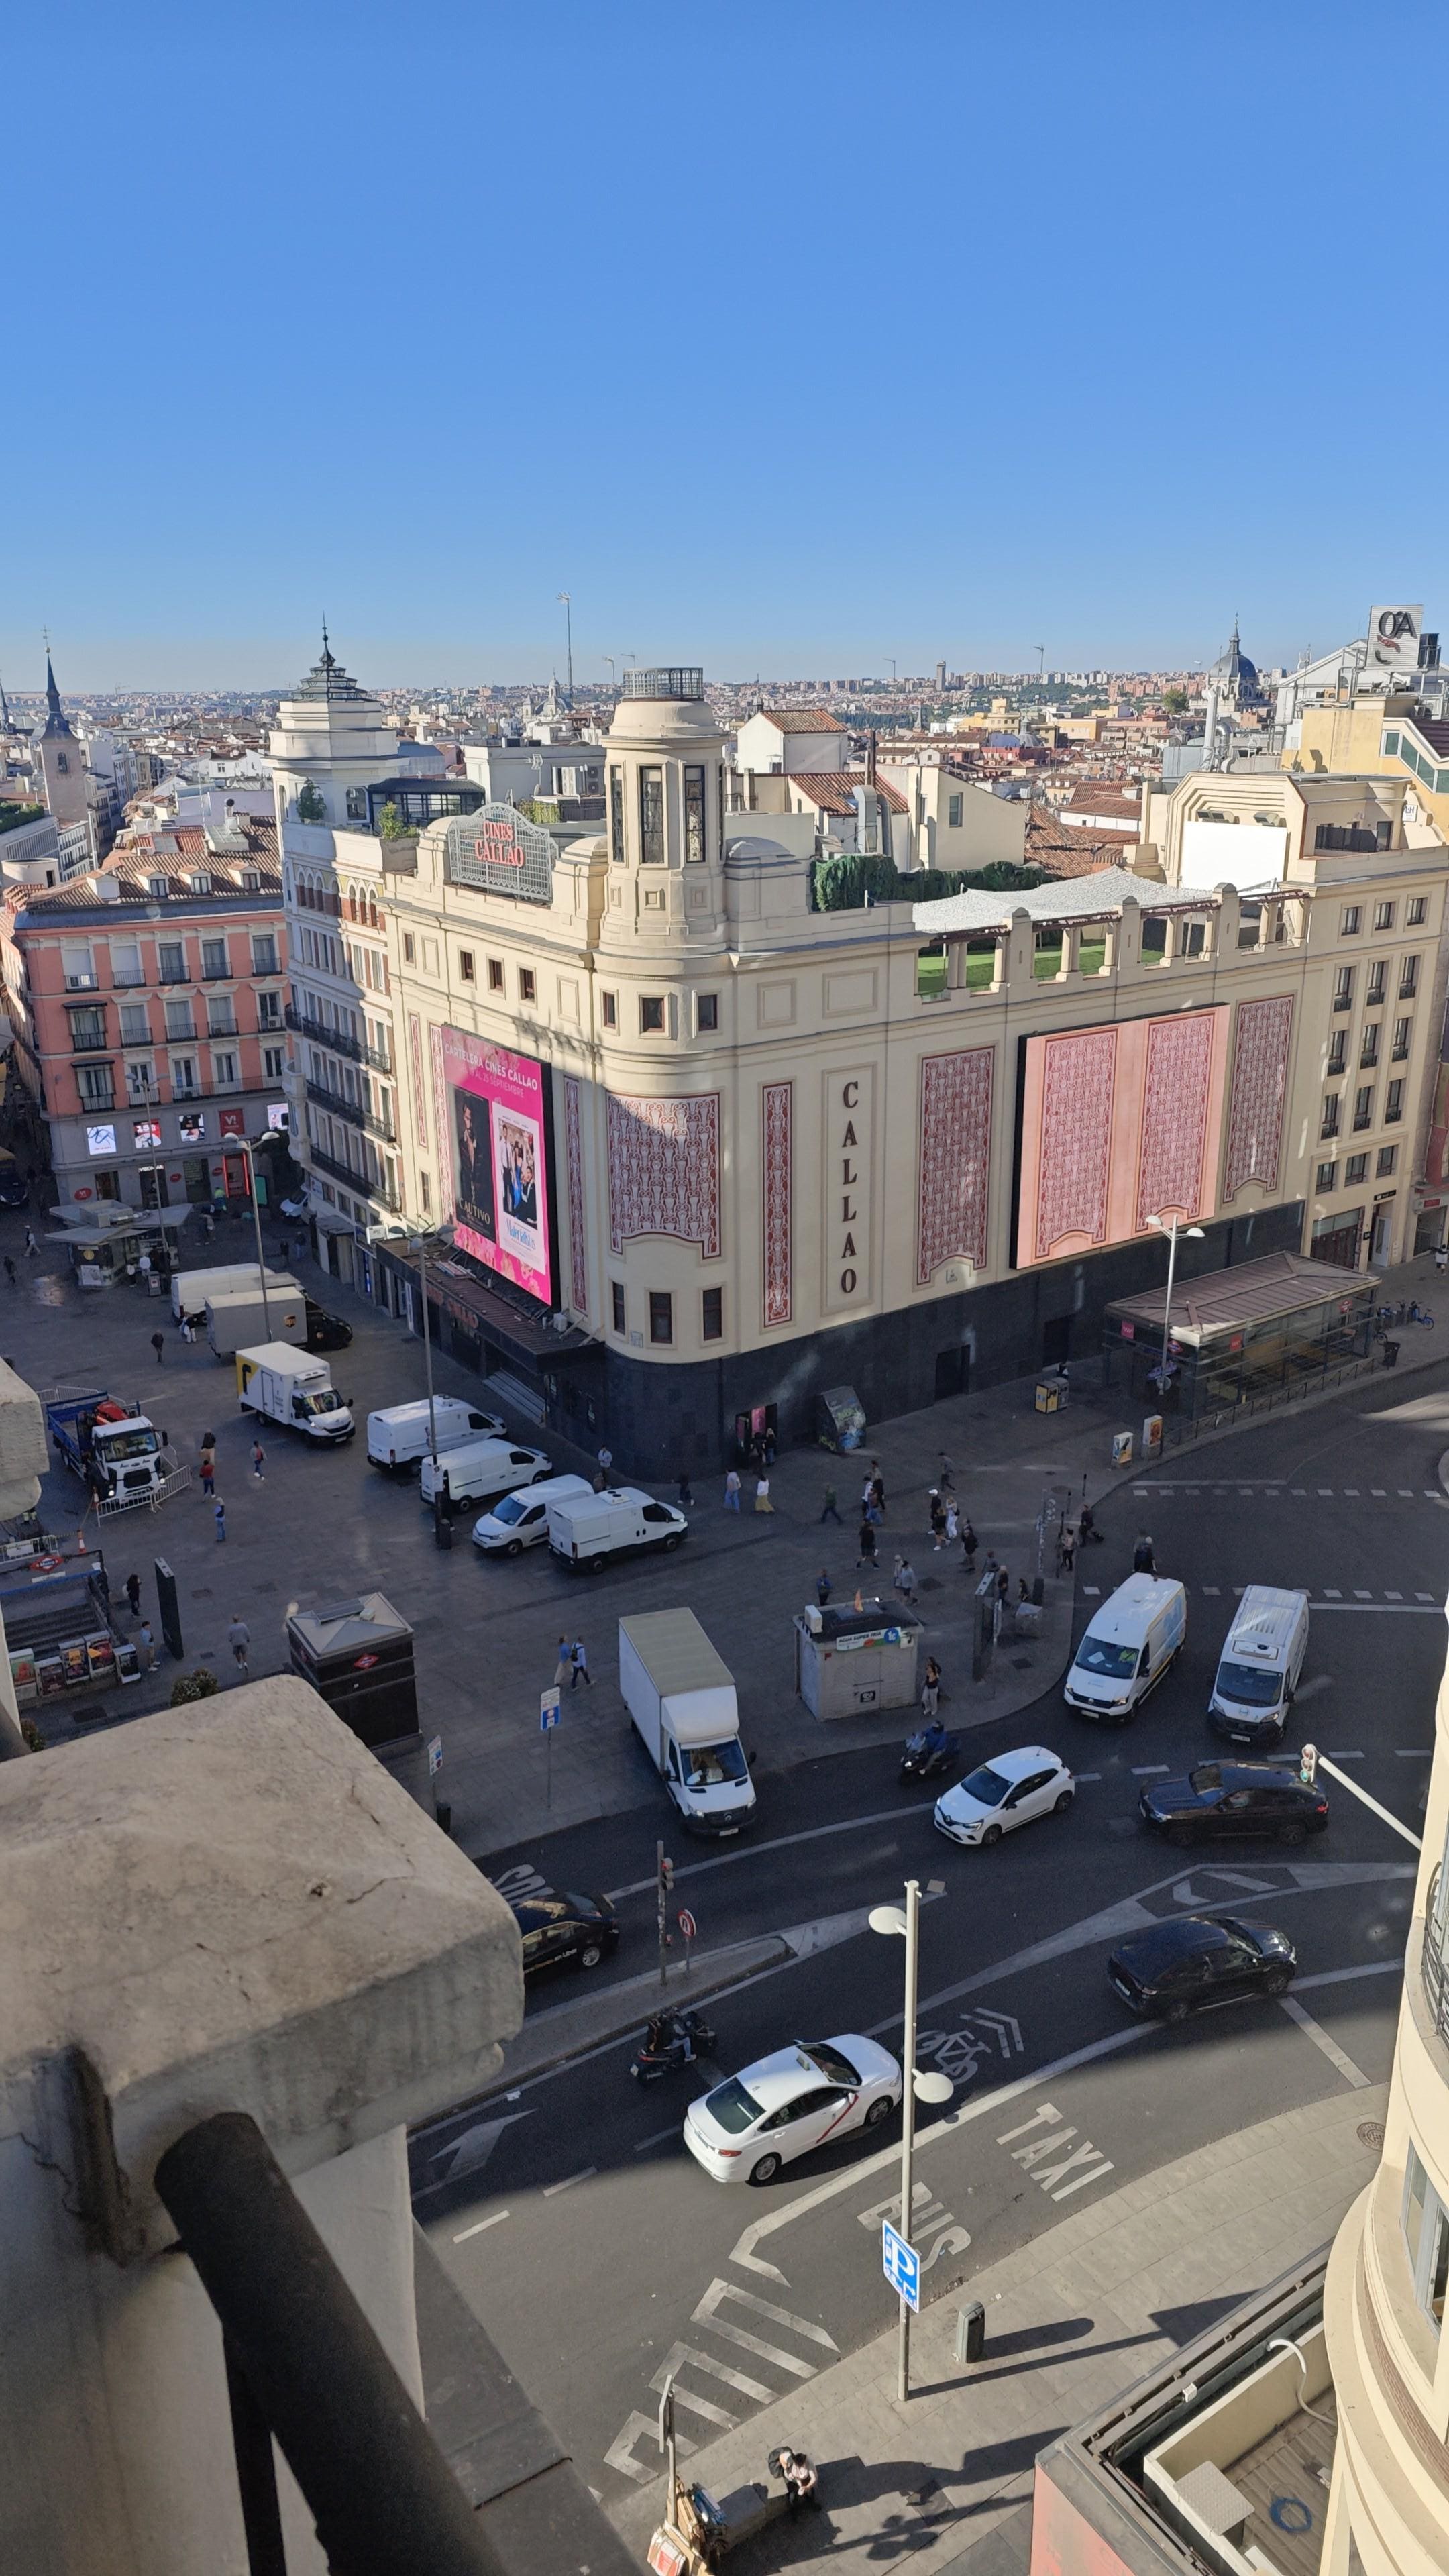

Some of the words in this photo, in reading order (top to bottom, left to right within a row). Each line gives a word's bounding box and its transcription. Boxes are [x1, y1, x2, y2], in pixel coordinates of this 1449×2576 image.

[483, 820, 515, 841] CINES
[475, 839, 525, 867] CALLAO
[444, 1043, 484, 1069] CARTELERA
[485, 1060, 506, 1078] CINES
[508, 1069, 538, 1091] CALLAO
[490, 1075, 525, 1098] SEPTIEMBRE
[841, 1080, 859, 1294] CALLAO
[458, 1197, 490, 1224] CAUTIVO
[996, 2102, 1115, 2202] TAXI
[857, 2181, 972, 2275] BUS
